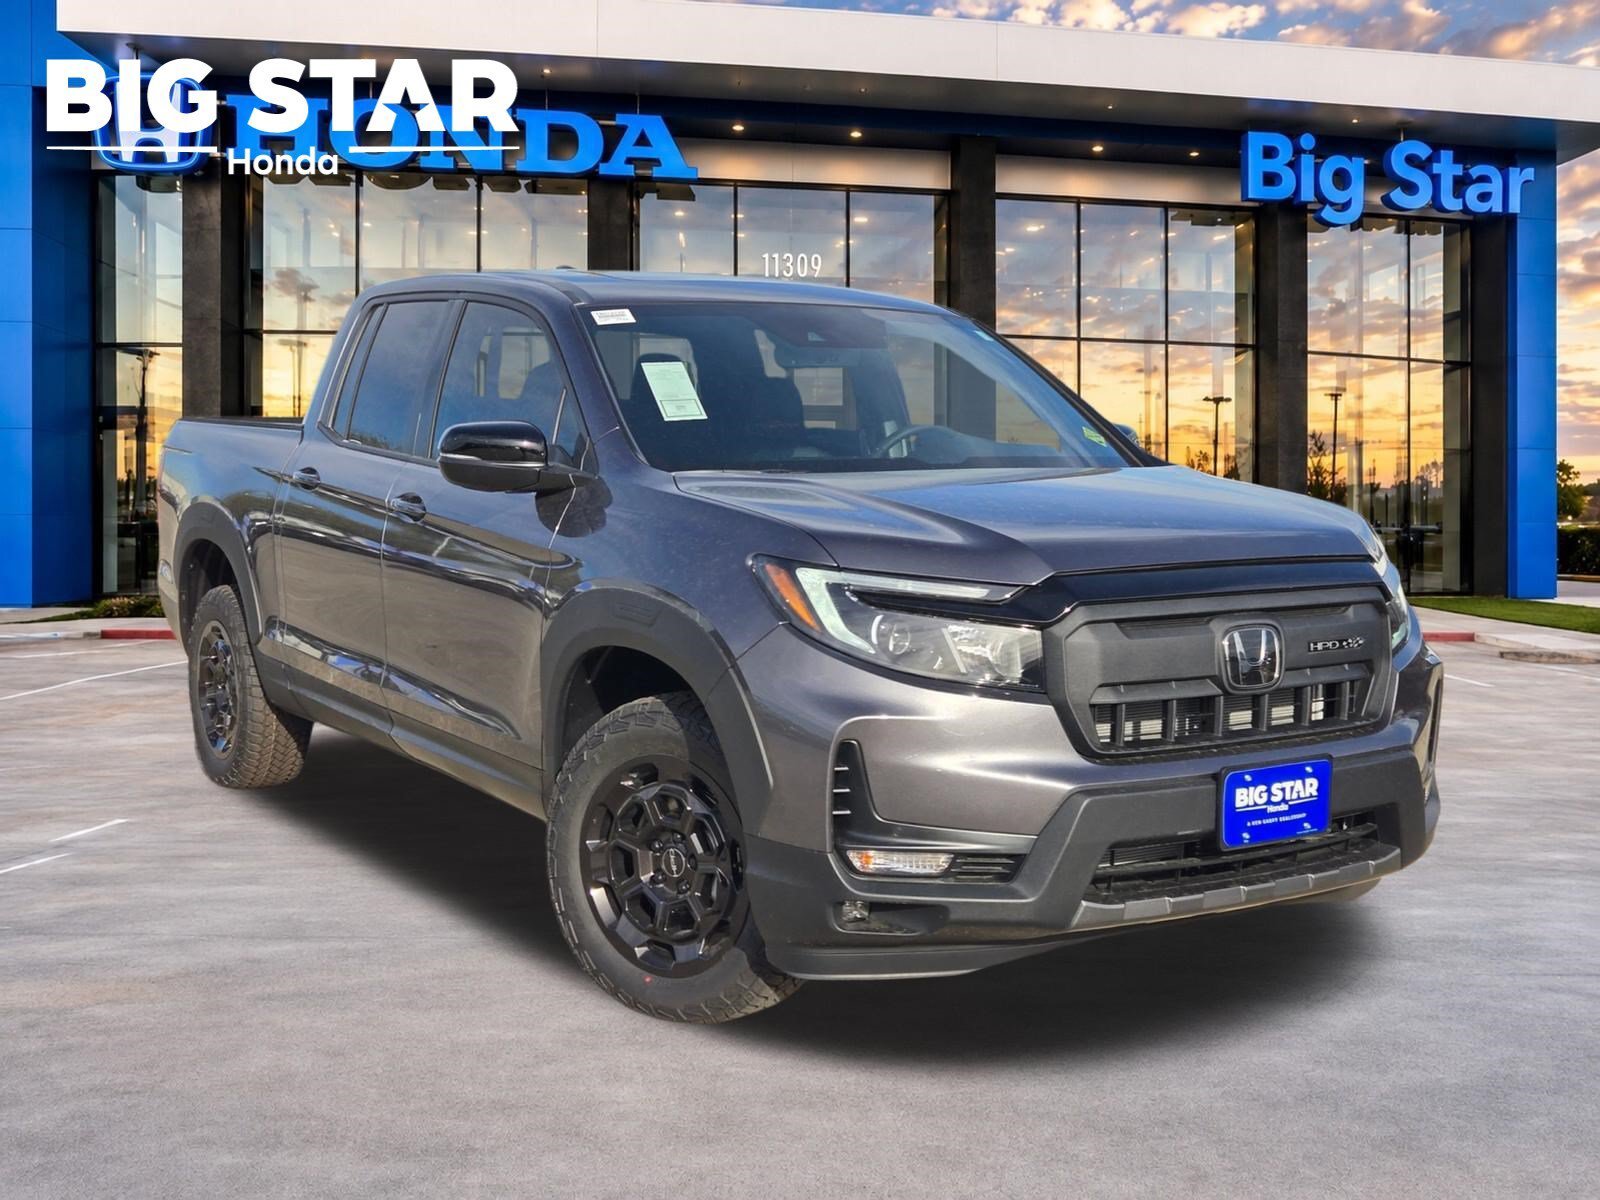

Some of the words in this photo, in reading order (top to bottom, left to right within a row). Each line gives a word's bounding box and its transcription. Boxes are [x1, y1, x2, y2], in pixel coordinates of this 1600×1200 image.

[1241, 131, 1366, 226] Big
[1381, 139, 1535, 214] Star
[762, 252, 822, 278] 11309
[1310, 640, 1340, 651] HPD
[1235, 785, 1268, 808] BIG
[1270, 777, 1319, 802] STAR
[1267, 802, 1289, 813] Honda
